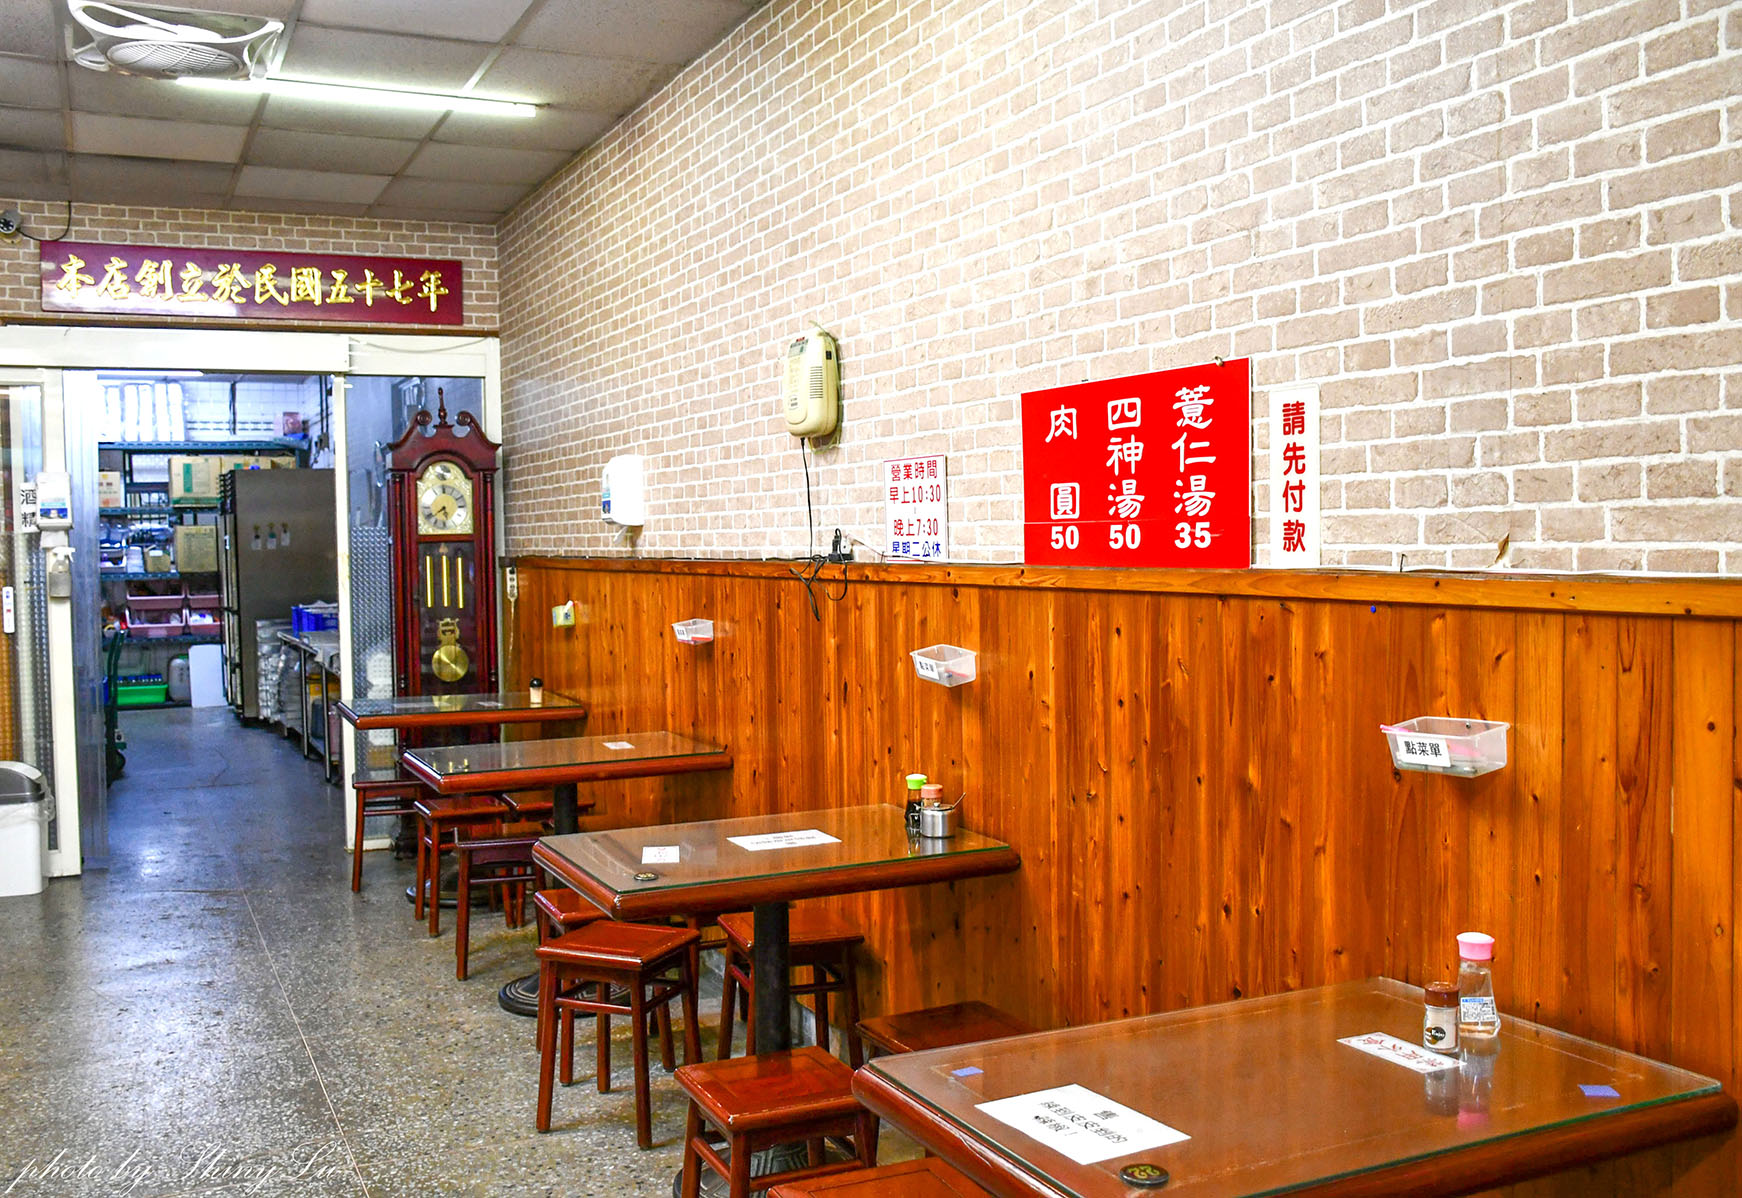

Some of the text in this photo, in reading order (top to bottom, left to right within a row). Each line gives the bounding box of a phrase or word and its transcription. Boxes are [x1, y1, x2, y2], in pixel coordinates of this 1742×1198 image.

[56, 254, 449, 313] 本店創立於民國五十七年
[890, 460, 938, 481] 營業時間
[1106, 397, 1146, 550] 四神湯 50
[1171, 384, 1217, 549] 薏仁湯 35
[1282, 401, 1306, 553] 請先付款
[889, 484, 942, 504] 早上10:30
[893, 518, 939, 536] 晚上7:30
[1050, 525, 1080, 550] 50
[1404, 740, 1442, 757] 點菜單
